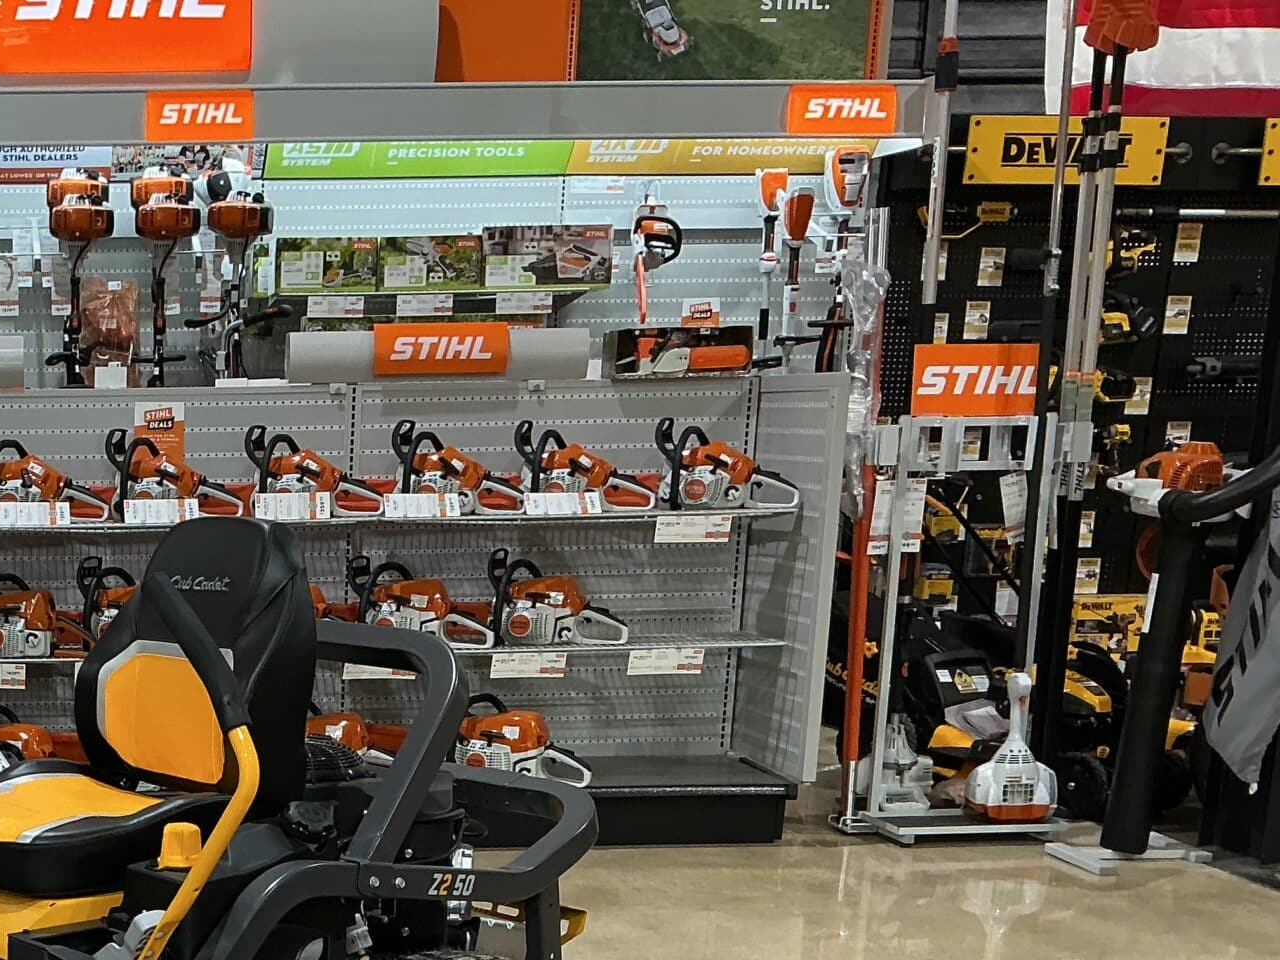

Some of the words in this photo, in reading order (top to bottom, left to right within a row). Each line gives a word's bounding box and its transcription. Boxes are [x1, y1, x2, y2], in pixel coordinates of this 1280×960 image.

[159, 102, 243, 125] STIHL
[804, 97, 888, 120] STIHL
[33, 153, 79, 161] DEALERS
[387, 147, 471, 158] PRECISION
[475, 146, 526, 157] TOOLS
[691, 145, 724, 157] FOR
[281, 158, 332, 167] SYSTEM
[586, 154, 638, 163] SYSTEM
[585, 230, 607, 238] STIHL
[389, 335, 493, 361] STIHL
[916, 365, 1038, 396] STIHL
[145, 409, 171, 421] STIHL
[149, 420, 173, 429] DEALS
[169, 574, 192, 590] Cub
[192, 576, 231, 591] Cadet
[1080, 601, 1113, 612] DEWALT
[427, 873, 453, 896] Z2
[452, 874, 476, 896] 50
